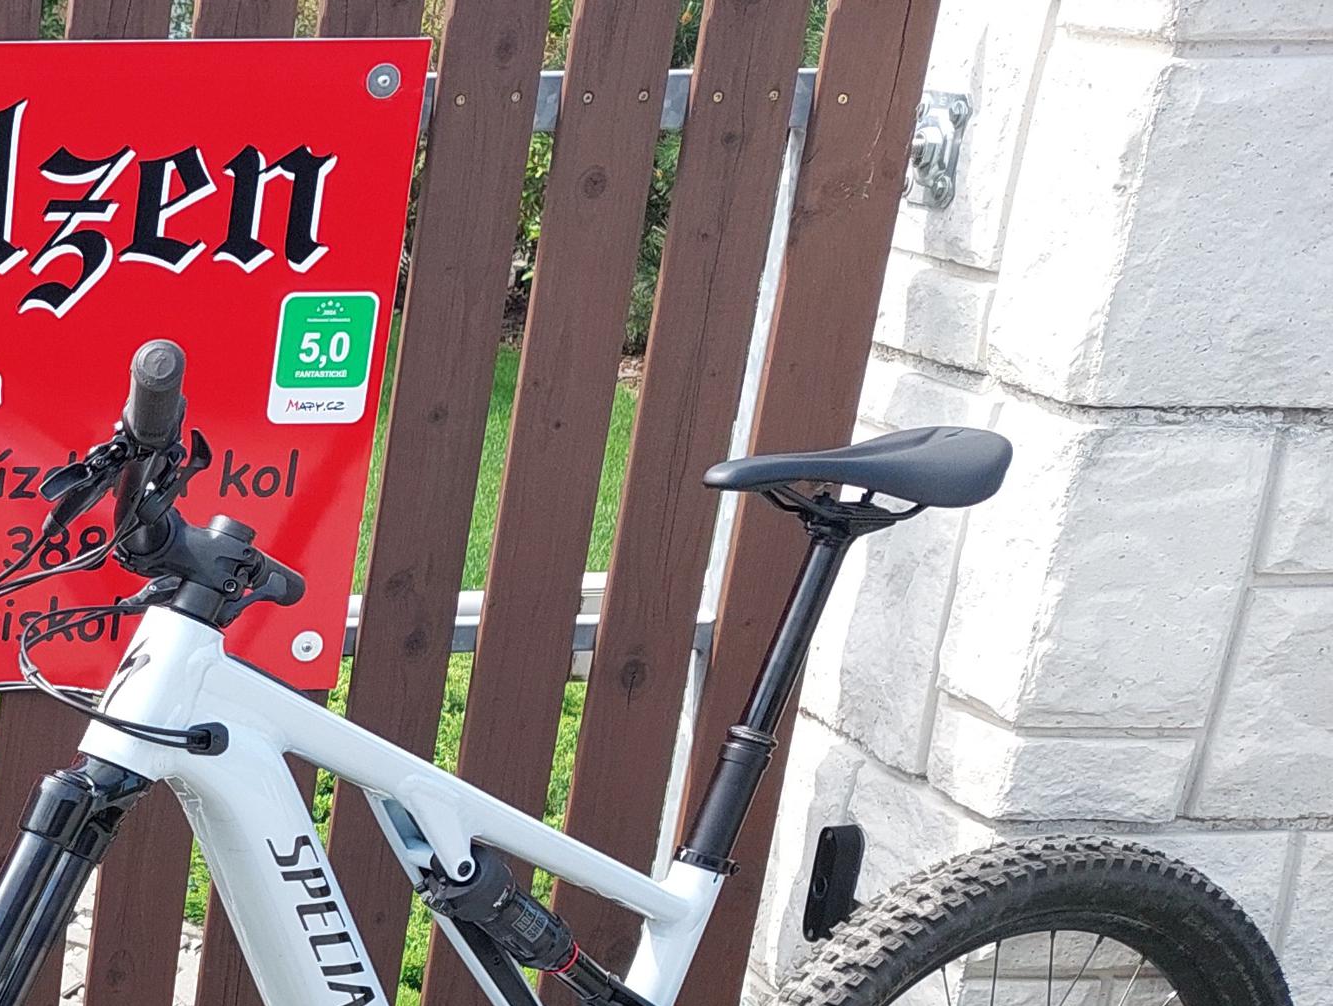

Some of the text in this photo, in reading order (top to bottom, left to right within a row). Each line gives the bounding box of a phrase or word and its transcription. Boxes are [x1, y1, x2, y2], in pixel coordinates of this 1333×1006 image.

[298, 331, 351, 368] 5,0
[220, 448, 300, 500] kol
[2, 525, 108, 571] 388
